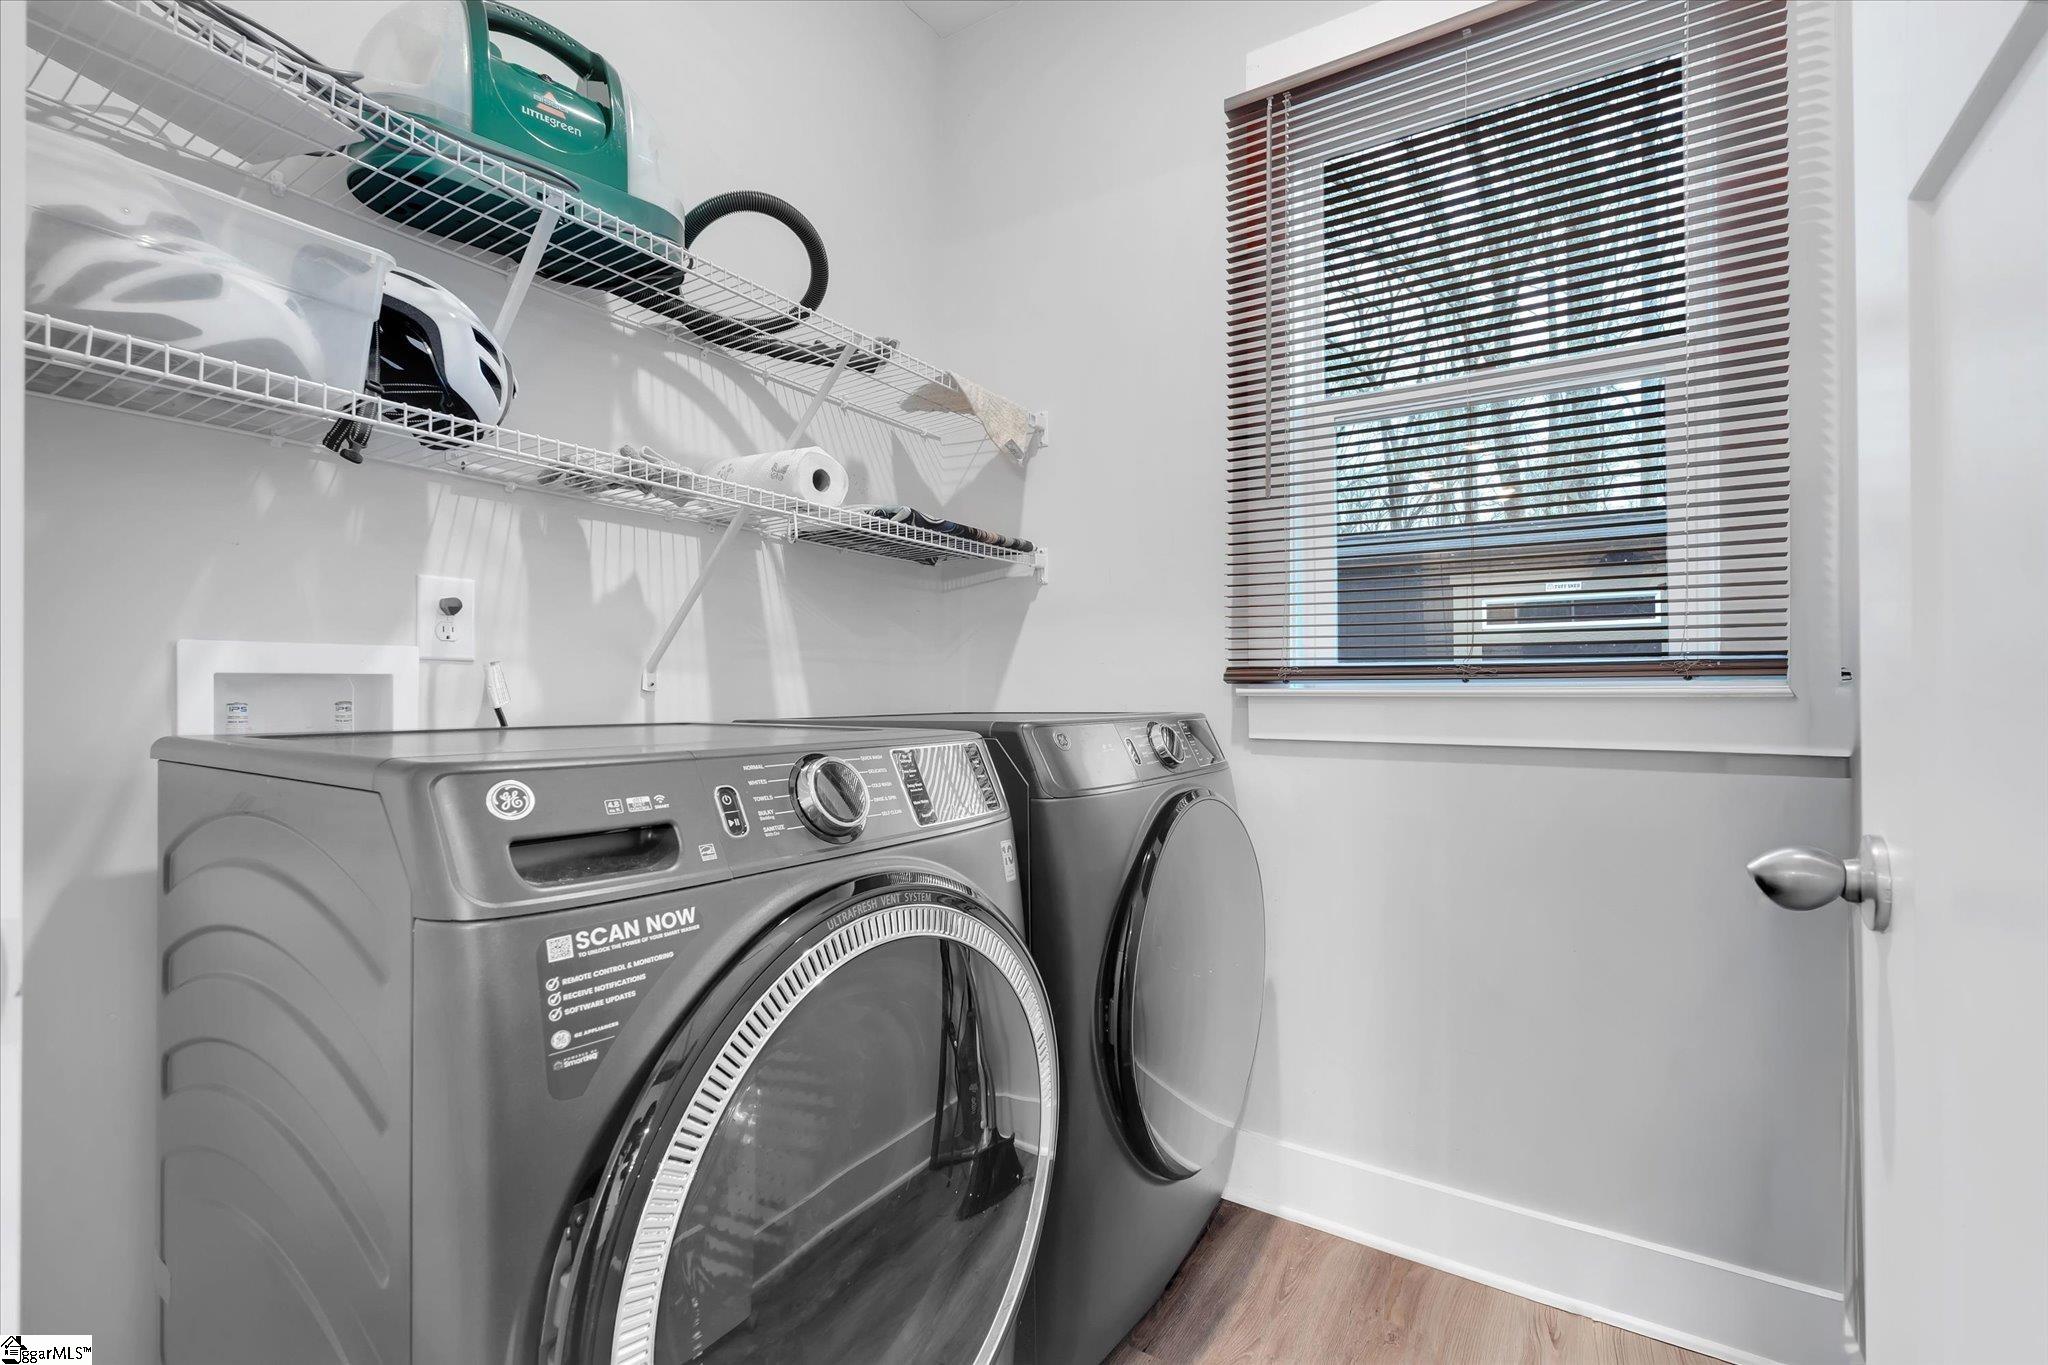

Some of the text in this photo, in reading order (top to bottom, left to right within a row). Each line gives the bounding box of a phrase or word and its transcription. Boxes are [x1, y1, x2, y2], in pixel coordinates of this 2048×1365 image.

[826, 892, 932, 930] ULTRAFRESH VENT SYSTEM
[575, 906, 696, 949] SCAN NOW
[587, 946, 611, 955] UNLOCK
[622, 939, 641, 947] POWER
[562, 972, 592, 985] REMOTE
[593, 964, 626, 978] CONTROL
[633, 951, 675, 967] MONITORING
[562, 973, 646, 1001] RECEIVE NOTIFICATIONS
[564, 990, 637, 1015] SOFTWARE UPDATES
[583, 1021, 619, 1036] APPLIANCES
